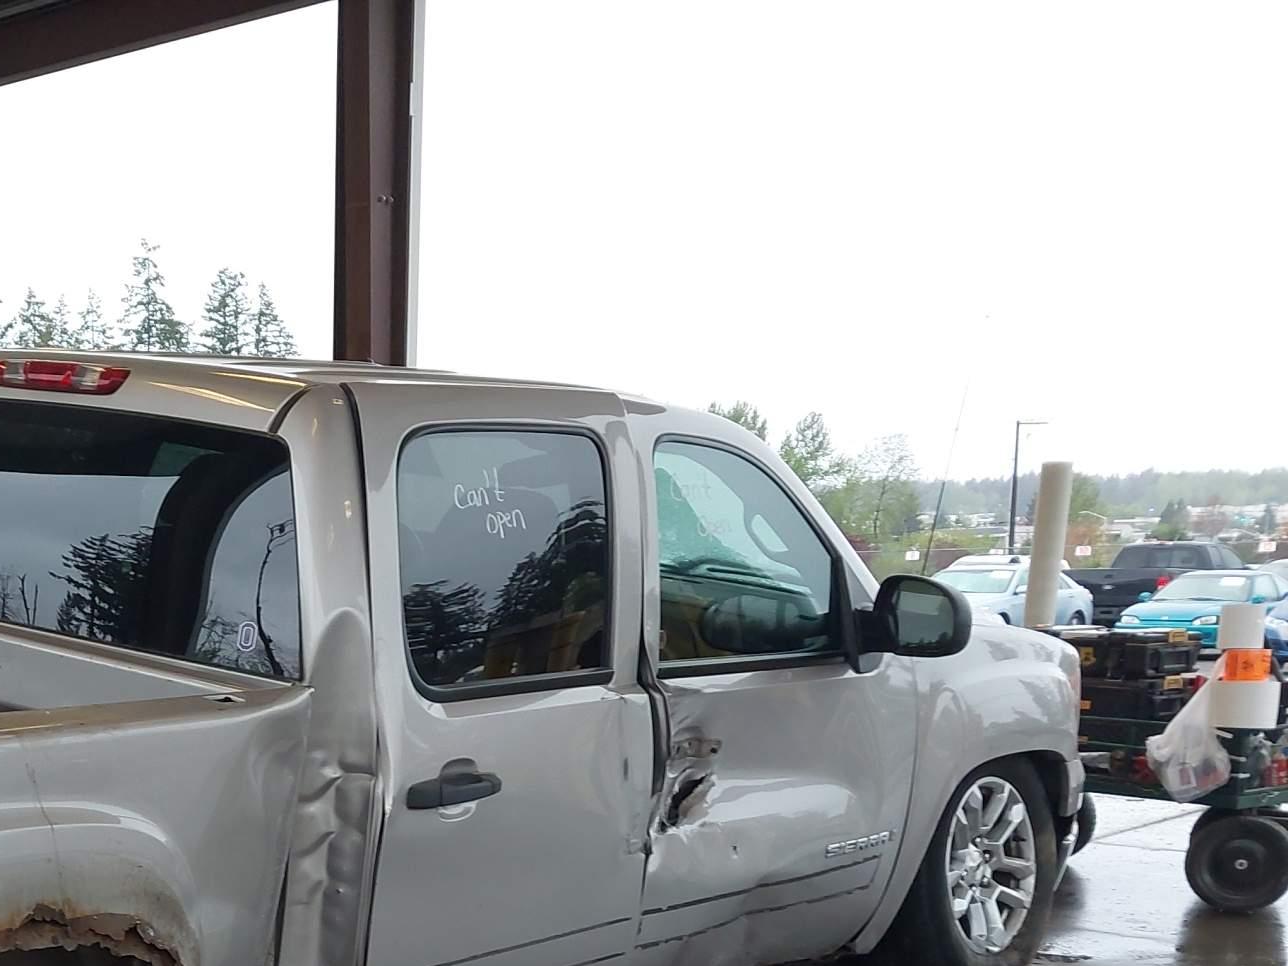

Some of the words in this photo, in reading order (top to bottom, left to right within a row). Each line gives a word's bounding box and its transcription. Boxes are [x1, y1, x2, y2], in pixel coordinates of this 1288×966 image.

[453, 467, 505, 509] Can't
[486, 509, 526, 539] open
[825, 830, 894, 858] SIERRA
